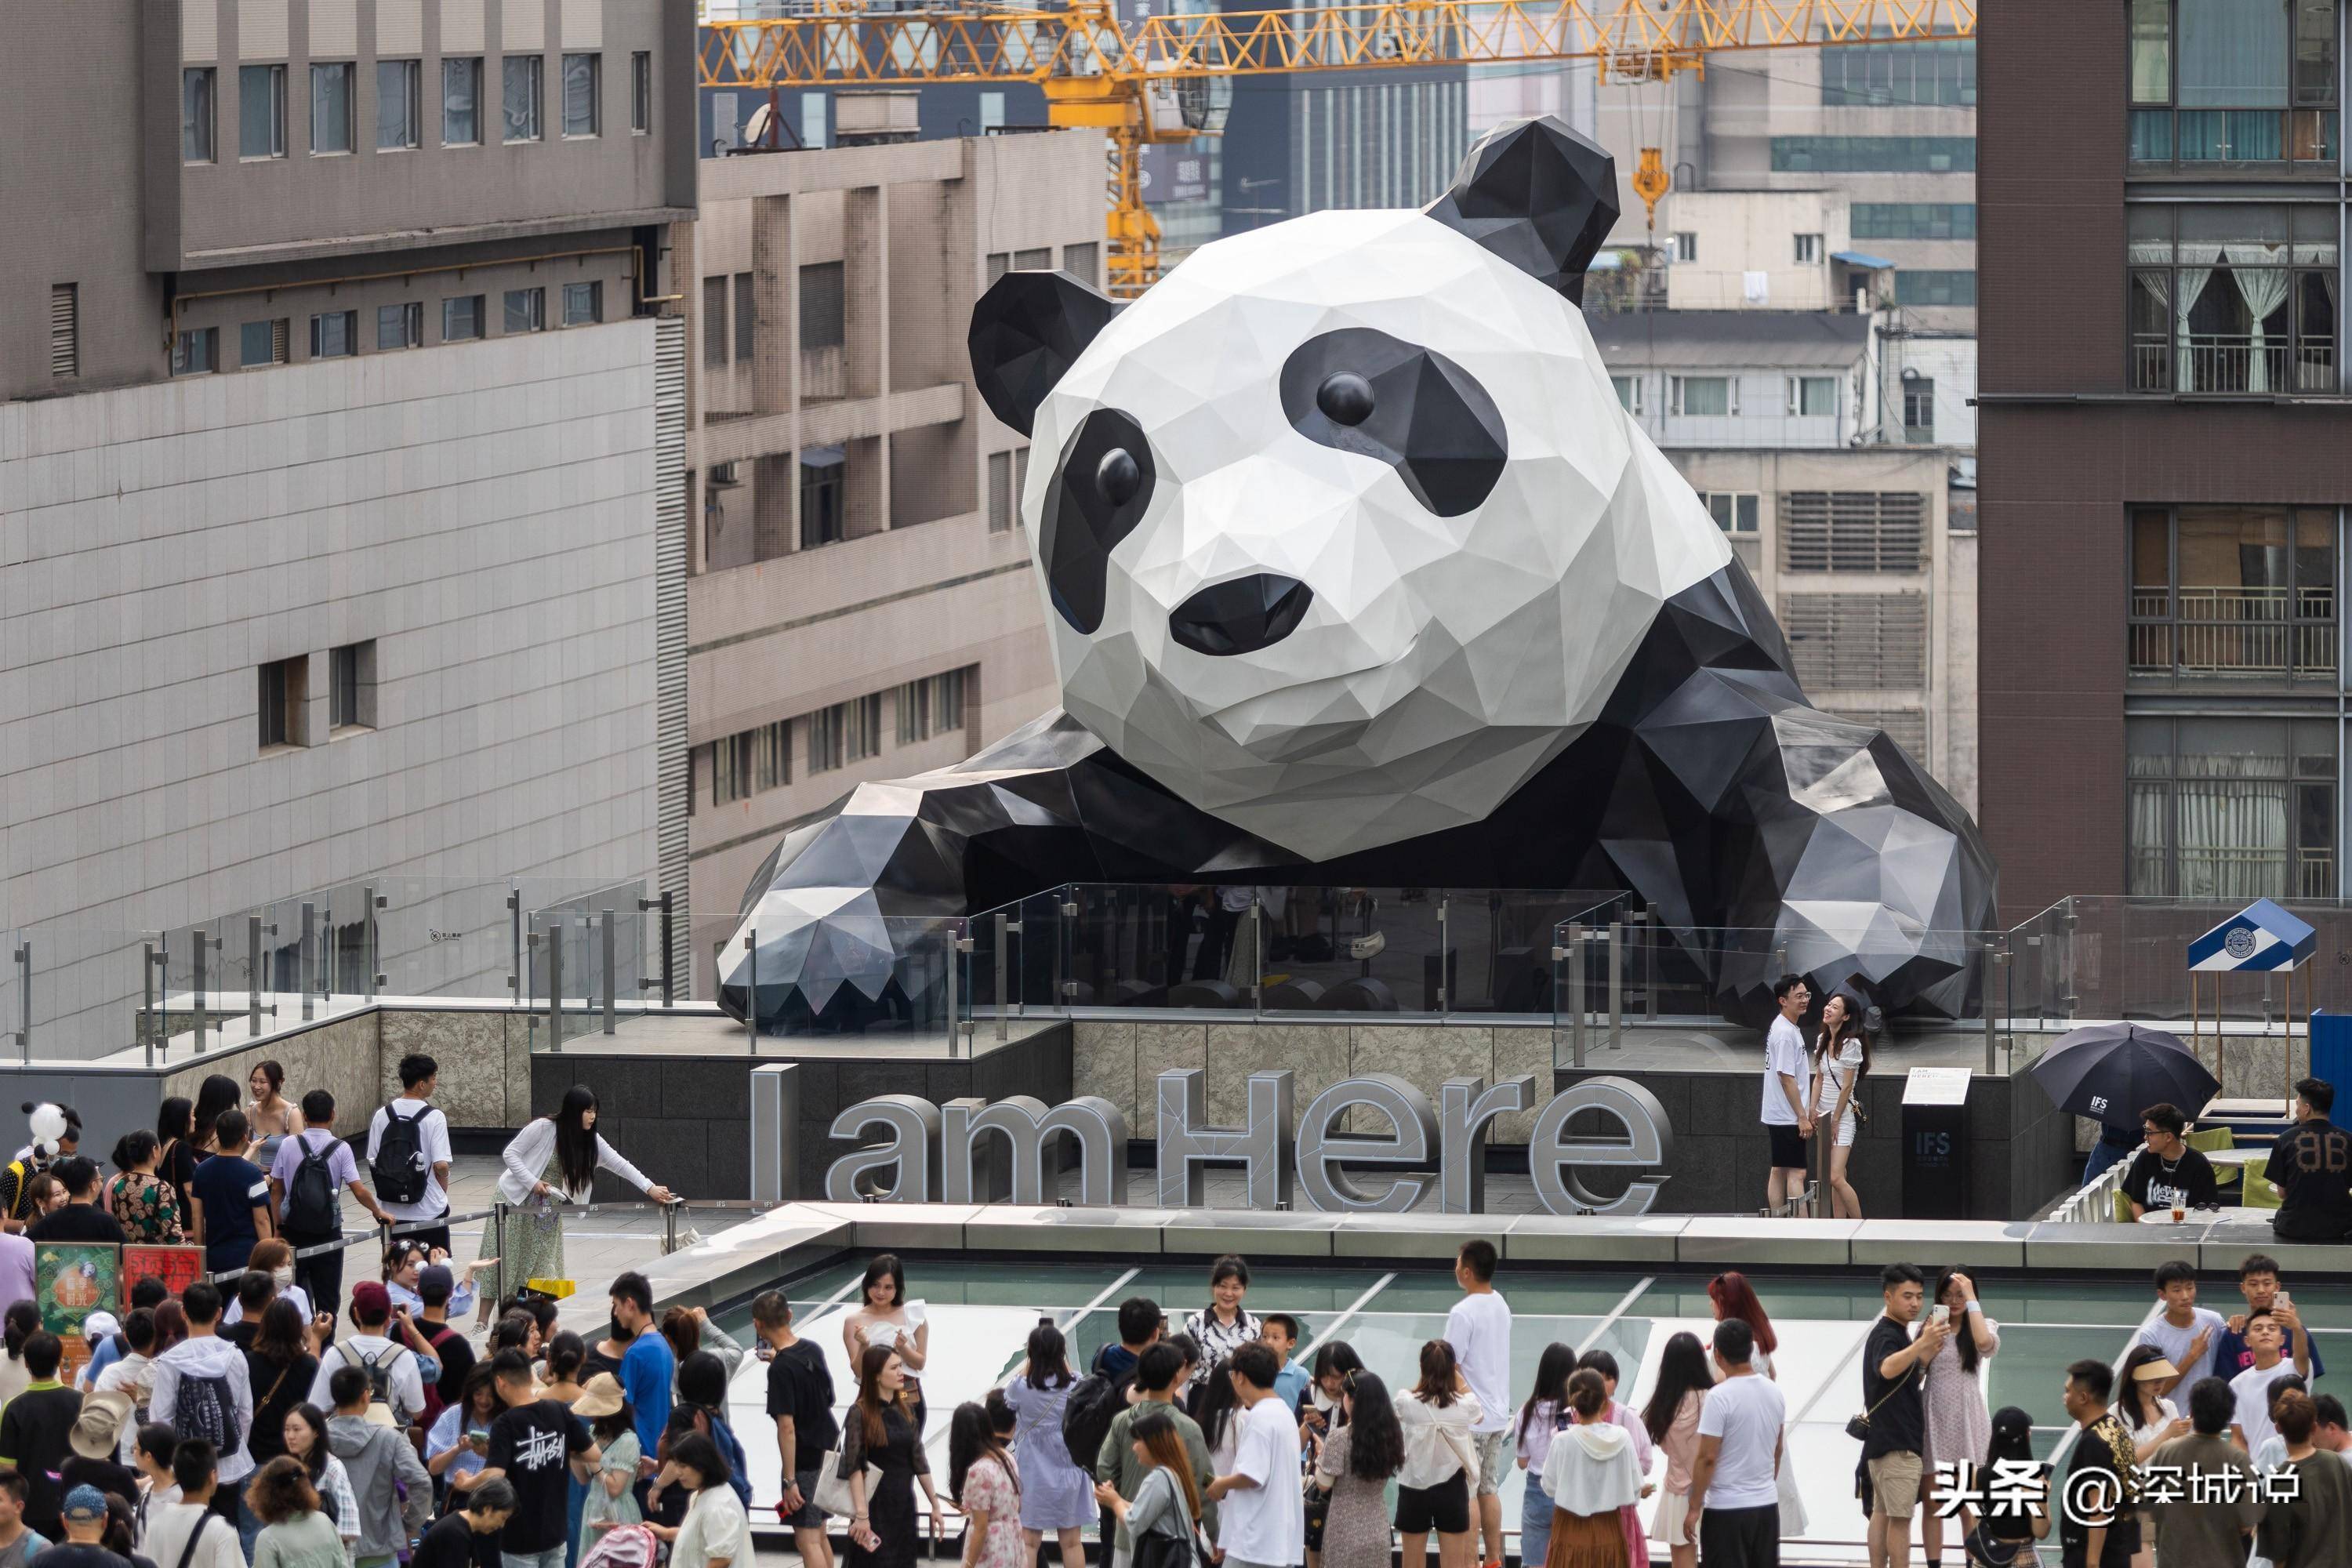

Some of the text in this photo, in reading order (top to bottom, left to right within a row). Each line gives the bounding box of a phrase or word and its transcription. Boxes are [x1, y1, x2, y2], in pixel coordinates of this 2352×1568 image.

[2091, 1096, 2108, 1109] IFS
[750, 1065, 1671, 1214] I am Here
[1916, 1132, 1951, 1155] IFS
